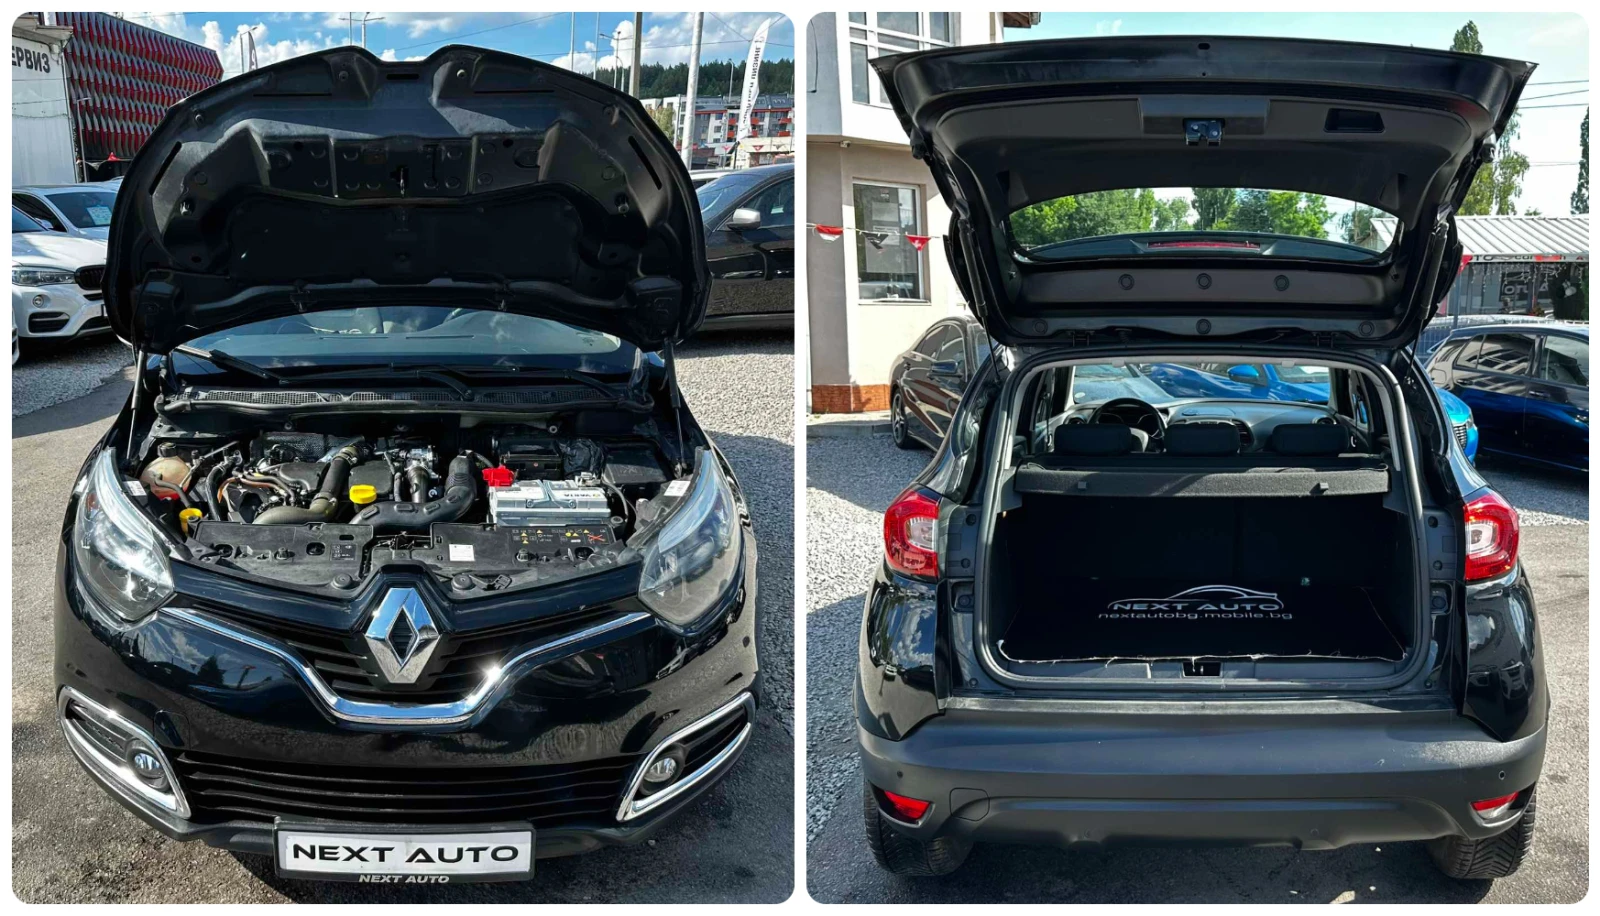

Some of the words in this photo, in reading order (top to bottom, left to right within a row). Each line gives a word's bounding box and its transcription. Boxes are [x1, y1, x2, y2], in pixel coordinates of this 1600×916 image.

[1099, 611, 1293, 620] nextautobg.mobile.bg
[293, 843, 395, 863] NEXT
[405, 845, 519, 864] AUTO
[358, 874, 402, 883] NEXT
[404, 874, 450, 884] AUTO
